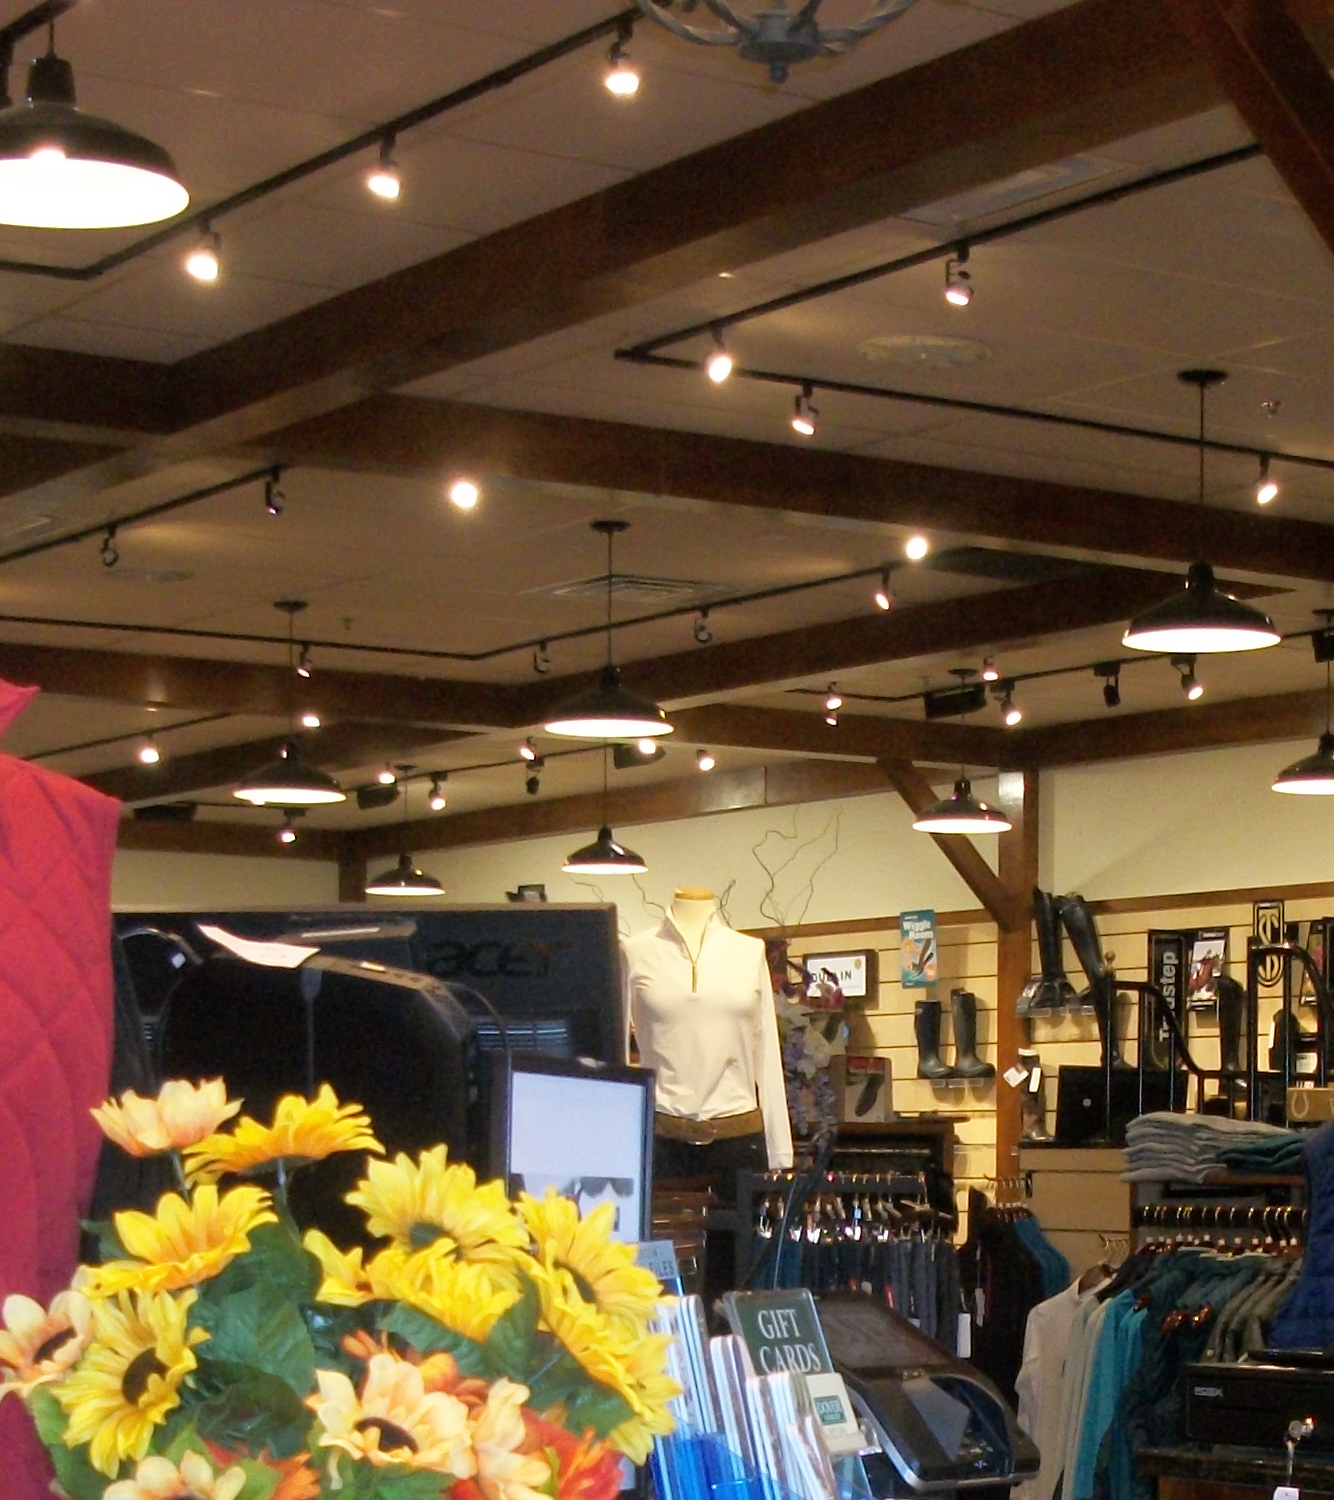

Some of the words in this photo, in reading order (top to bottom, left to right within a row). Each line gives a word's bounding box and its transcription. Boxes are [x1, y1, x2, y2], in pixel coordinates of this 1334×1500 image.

[426, 941, 573, 978] acer
[757, 1308, 802, 1340] GIFT
[759, 1342, 822, 1375] CARDS
